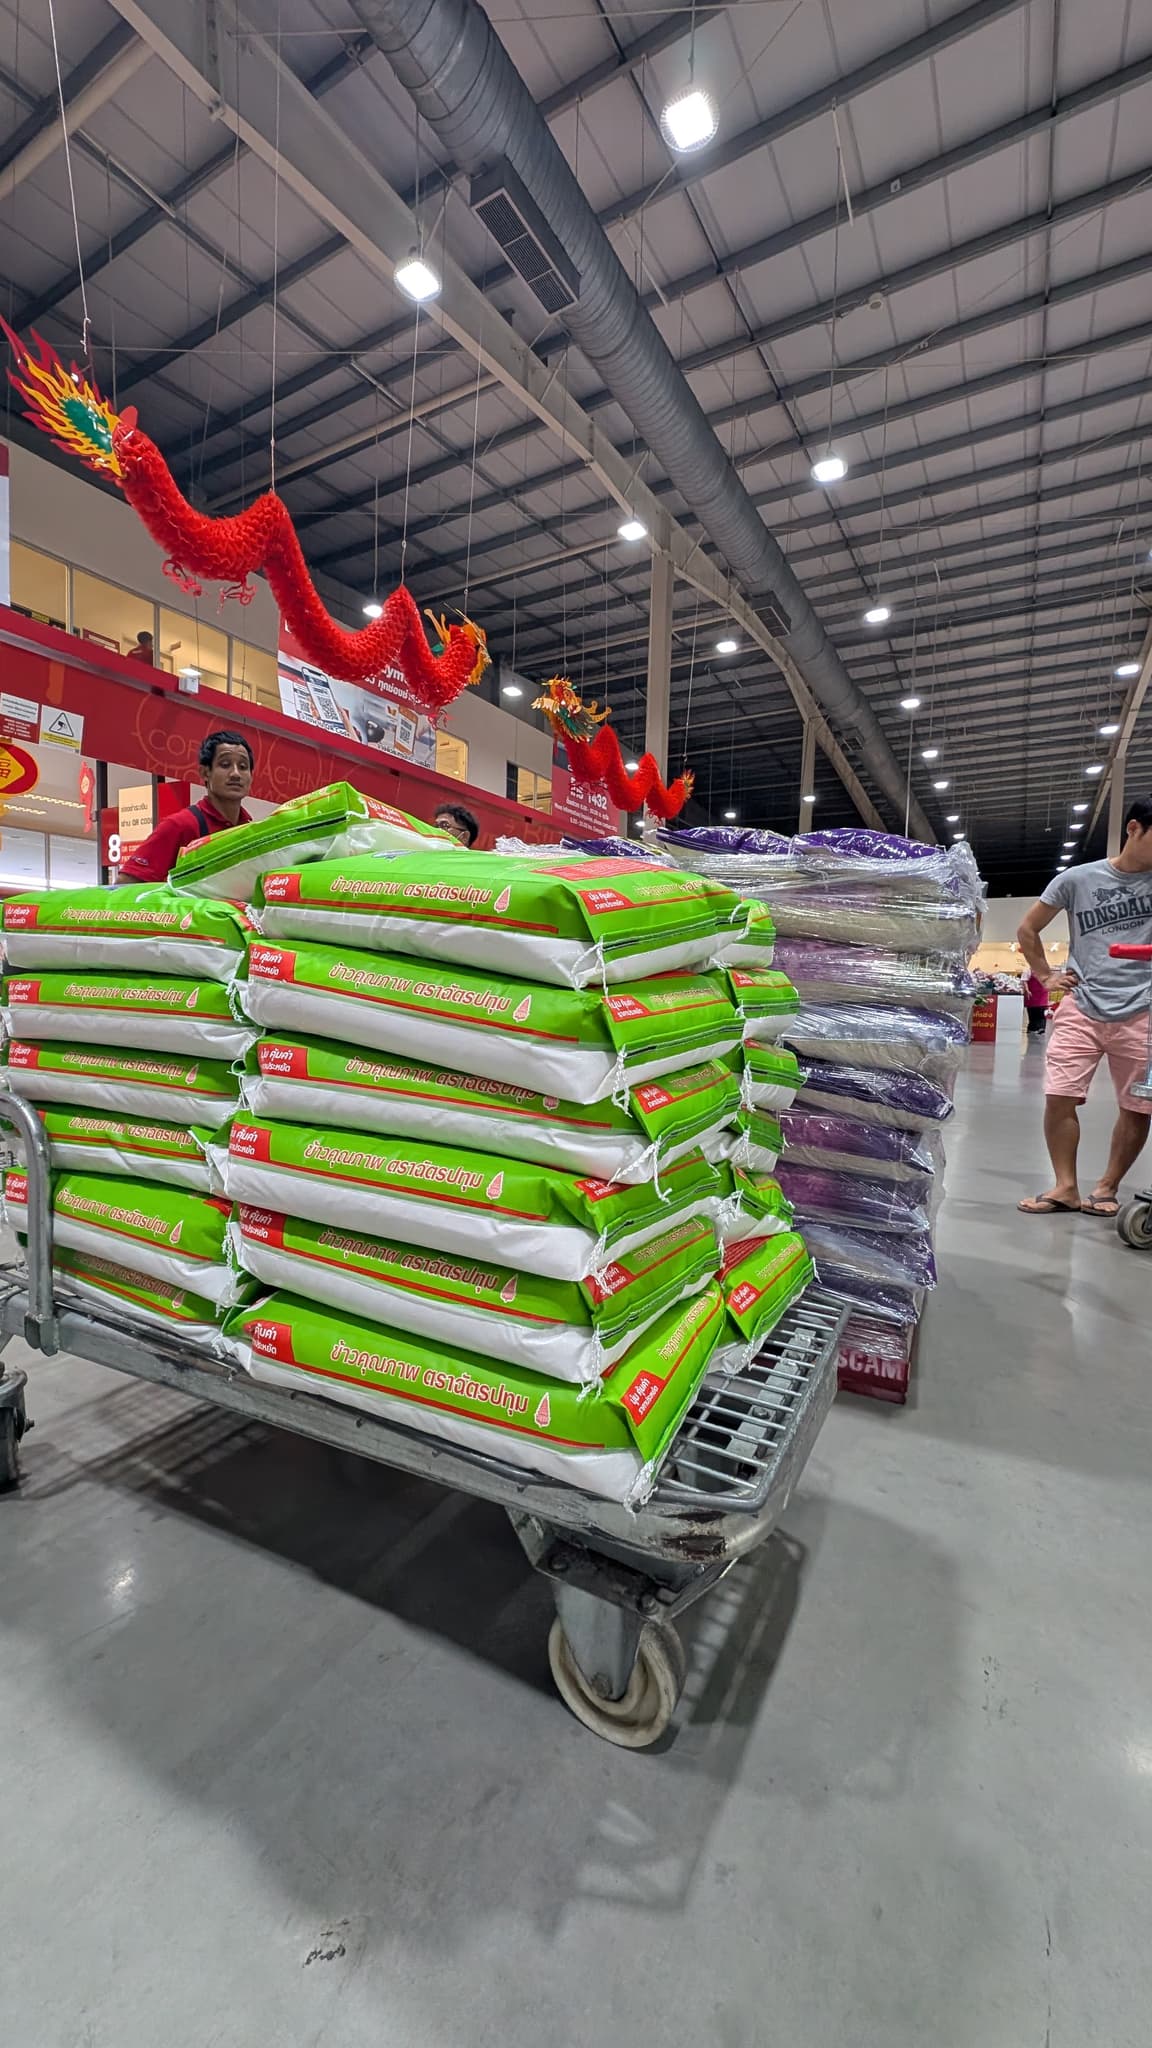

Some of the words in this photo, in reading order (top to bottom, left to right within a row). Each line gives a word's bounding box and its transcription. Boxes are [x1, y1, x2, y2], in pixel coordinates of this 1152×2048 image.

[588, 793, 607, 810] 1432
[108, 834, 120, 862] 8
[331, 875, 401, 898] ข้าวคุณภาพ
[403, 881, 493, 908] ตราฉัตรปทุม
[61, 905, 113, 923] ข้าวคุณภาพ
[114, 908, 180, 928] ตราฉัตรปทุม
[1101, 920, 1144, 935] LONDON
[64, 982, 119, 1002] ข้าวคุณภาพ
[121, 986, 186, 1006] ตราฉัตรปทุม
[329, 961, 410, 993] ข้าวคุณภาพ
[413, 982, 512, 1014] ตราฉัตรปทุม
[62, 1051, 118, 1071] ข้าวคุณภาพ
[120, 1057, 185, 1078] ตราฉัตรปทุม
[269, 1049, 293, 1061] คุ้มค่า
[345, 1055, 433, 1083] ข้าวคุณภาพ
[436, 1069, 538, 1104] ตราฉตรปทุม
[69, 1116, 127, 1135] ขาวคุณภาพ
[127, 1124, 194, 1148] ตราฉตรปทุม
[304, 1139, 386, 1171] ข้าวคุณภาพ
[386, 1159, 484, 1192] ตราฉัตรปทุม
[56, 1187, 108, 1216] ข้าวคุณภาพ
[108, 1207, 171, 1237] ตราฉัตรปทุม
[249, 1209, 272, 1225] คุ้มค่า
[318, 1228, 399, 1265] ข้าวคุณภาพ
[400, 1252, 499, 1293] ตราฉัตรปทุม
[330, 1339, 421, 1382] ข้าวคุณภาพ
[422, 1367, 530, 1420] ตราฉัตรปทุม
